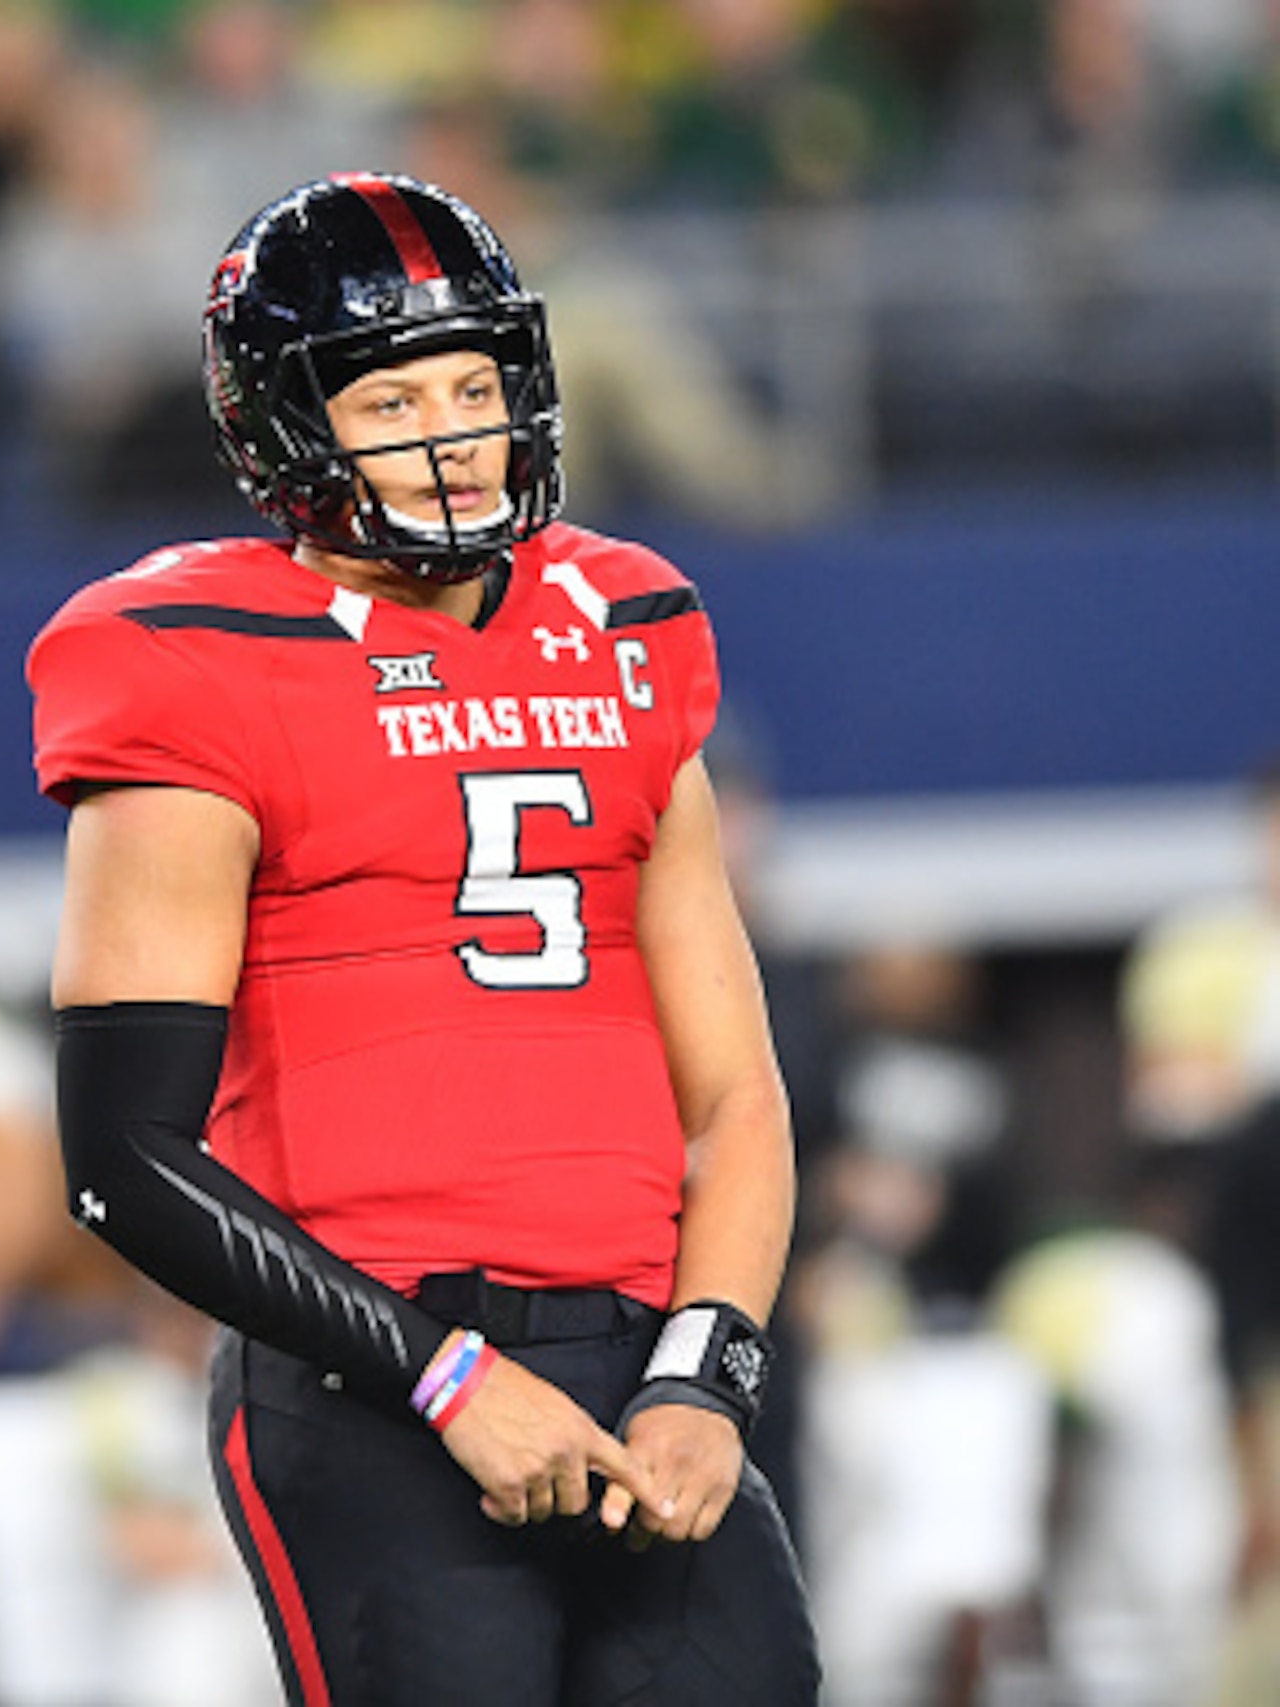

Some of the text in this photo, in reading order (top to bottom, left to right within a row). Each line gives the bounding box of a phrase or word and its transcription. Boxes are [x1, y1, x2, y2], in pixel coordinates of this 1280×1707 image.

[614, 638, 654, 710] C
[377, 696, 629, 757] TEXAS TECH
[452, 768, 594, 990] 5
